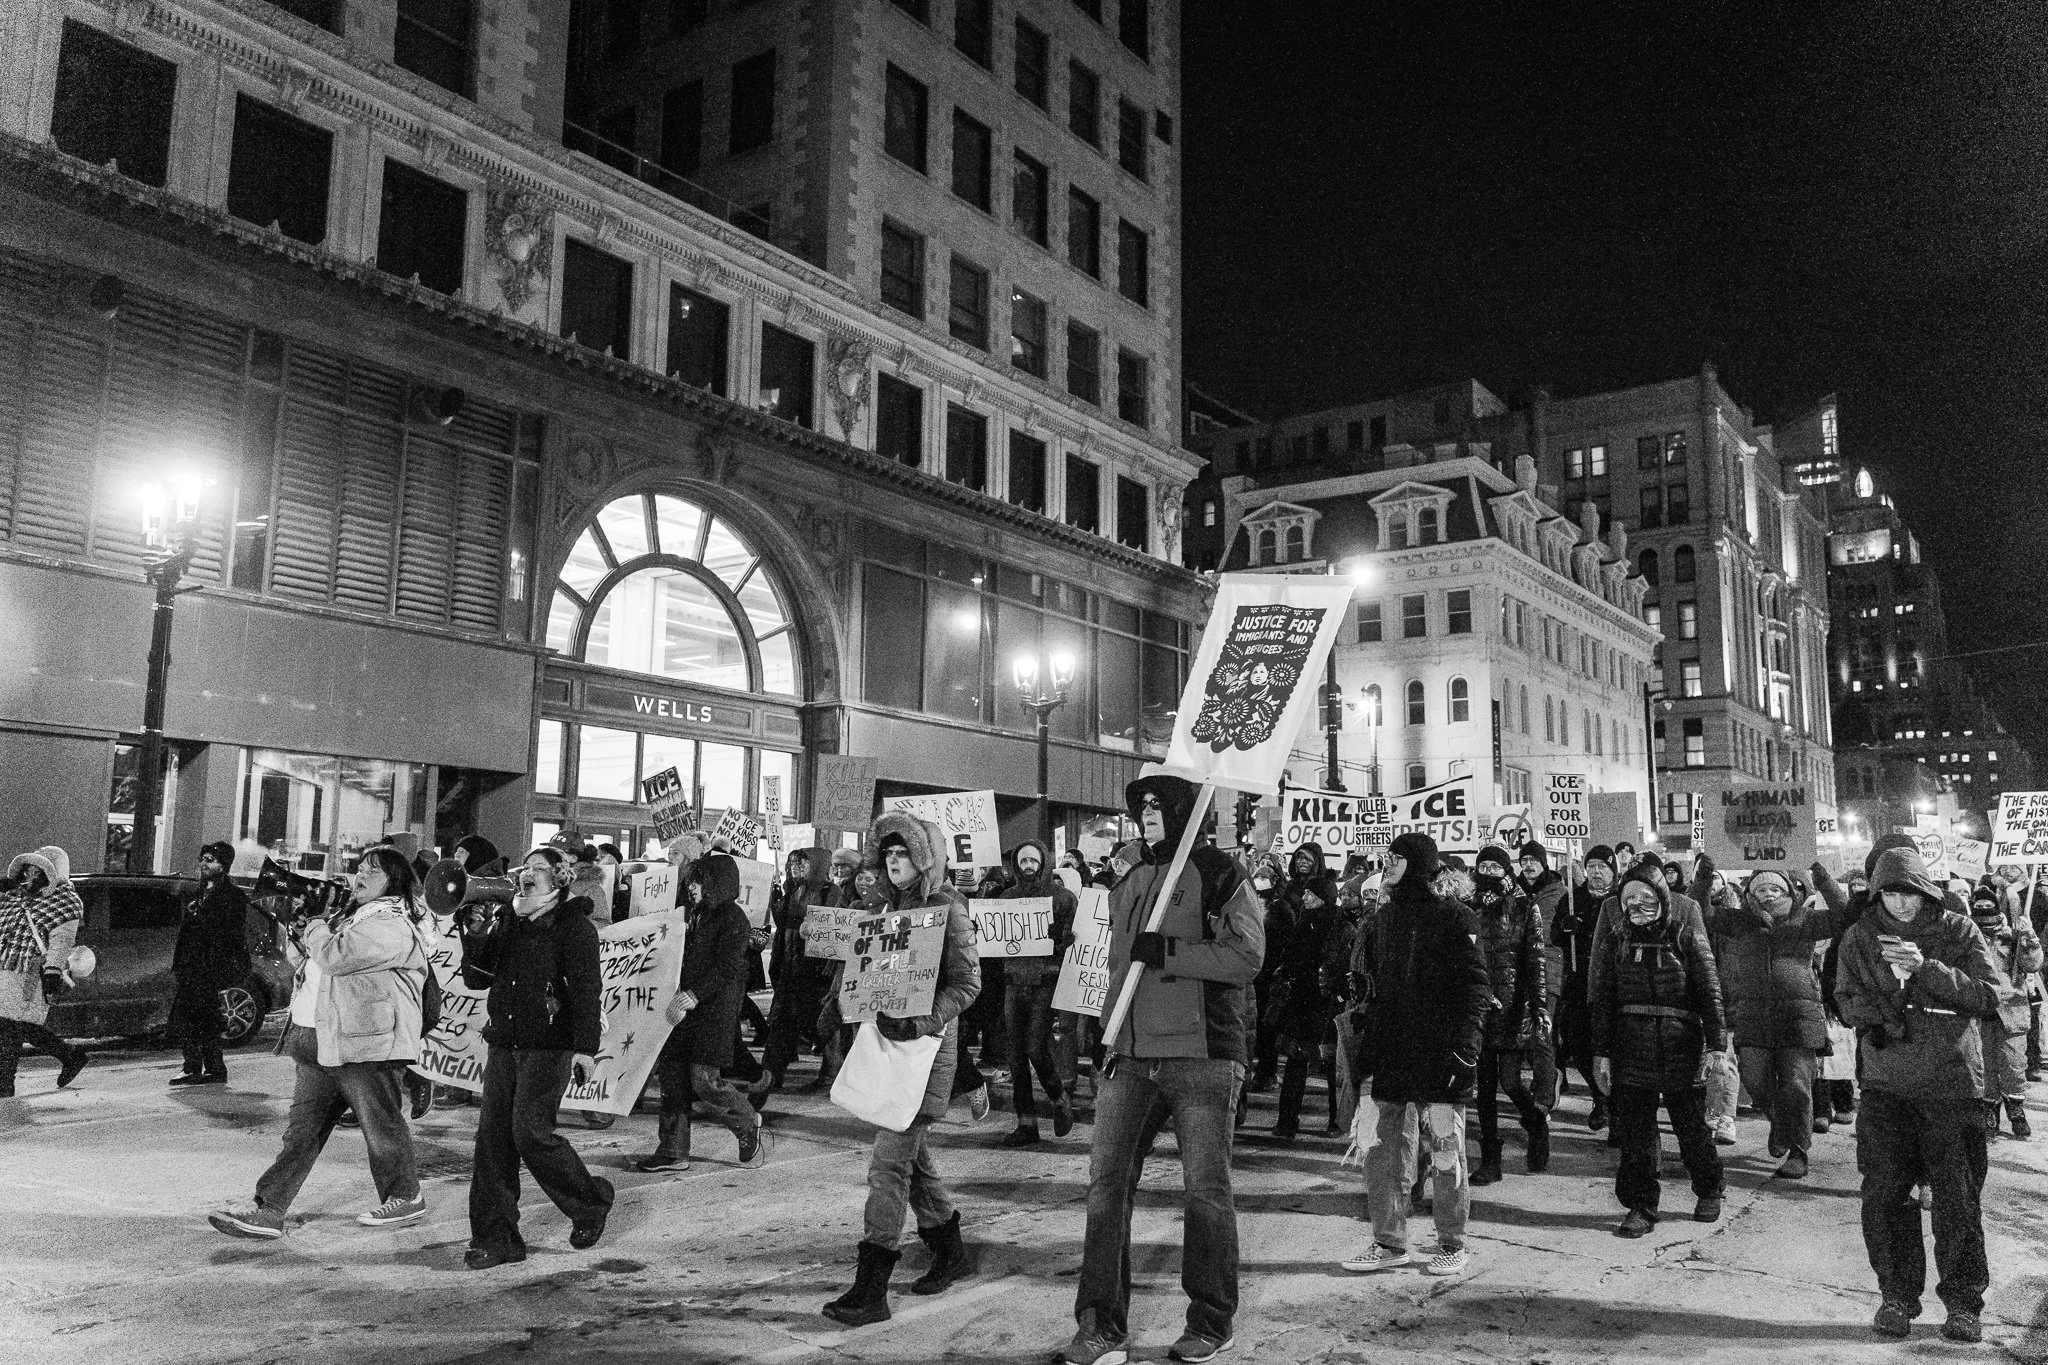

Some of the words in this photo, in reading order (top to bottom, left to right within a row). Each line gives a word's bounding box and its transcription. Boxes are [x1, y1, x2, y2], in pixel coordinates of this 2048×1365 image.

[1236, 615, 1287, 630] JUSTICE
[1288, 619, 1317, 633] FOR
[1235, 630, 1286, 642] IMMIGRANTS
[1286, 634, 1308, 645] AND
[1244, 644, 1284, 655] REFUGEES
[633, 695, 712, 723] WELLS
[825, 762, 873, 783] KILL
[1551, 775, 1579, 788] ICE
[645, 768, 680, 802] ICE
[825, 782, 873, 804] YOUR
[1357, 798, 1387, 813] KILLER
[1410, 788, 1467, 820] ICE
[1549, 791, 1582, 805] OUT
[2003, 795, 2028, 808] THE
[2029, 795, 2048, 807] RIG
[727, 808, 741, 822] NO
[742, 817, 759, 834] ICE
[1355, 811, 1391, 826] ICE
[1550, 808, 1582, 822] FOR
[2006, 807, 2024, 819] OF
[721, 817, 736, 831] NO
[735, 825, 759, 846] KINGS
[1287, 824, 1322, 846] OFF
[1327, 826, 1355, 846] OU
[1391, 819, 1473, 843] TREETS!
[1545, 823, 1588, 837] GOOD
[1815, 819, 1836, 833] CE
[2005, 820, 2031, 831] THE
[716, 825, 731, 838] NO
[730, 833, 749, 852] KKK
[1355, 832, 1391, 845] STREETS
[1994, 841, 2020, 857] THE
[2021, 838, 2048, 856] CAN
[1743, 846, 1787, 861] LAND
[643, 873, 670, 899] Fight
[858, 918, 887, 937] THE
[890, 909, 946, 932] POWER
[974, 911, 1032, 943] ABOLISH
[853, 936, 874, 956] OF
[878, 929, 912, 953] THE
[601, 947, 658, 980] PEOPLE
[1068, 943, 1109, 971] NEIG
[844, 979, 858, 993] IS
[862, 972, 901, 989] GREATER
[907, 966, 936, 983] THAN
[624, 986, 659, 1012] THE
[1082, 987, 1107, 1008] ICE
